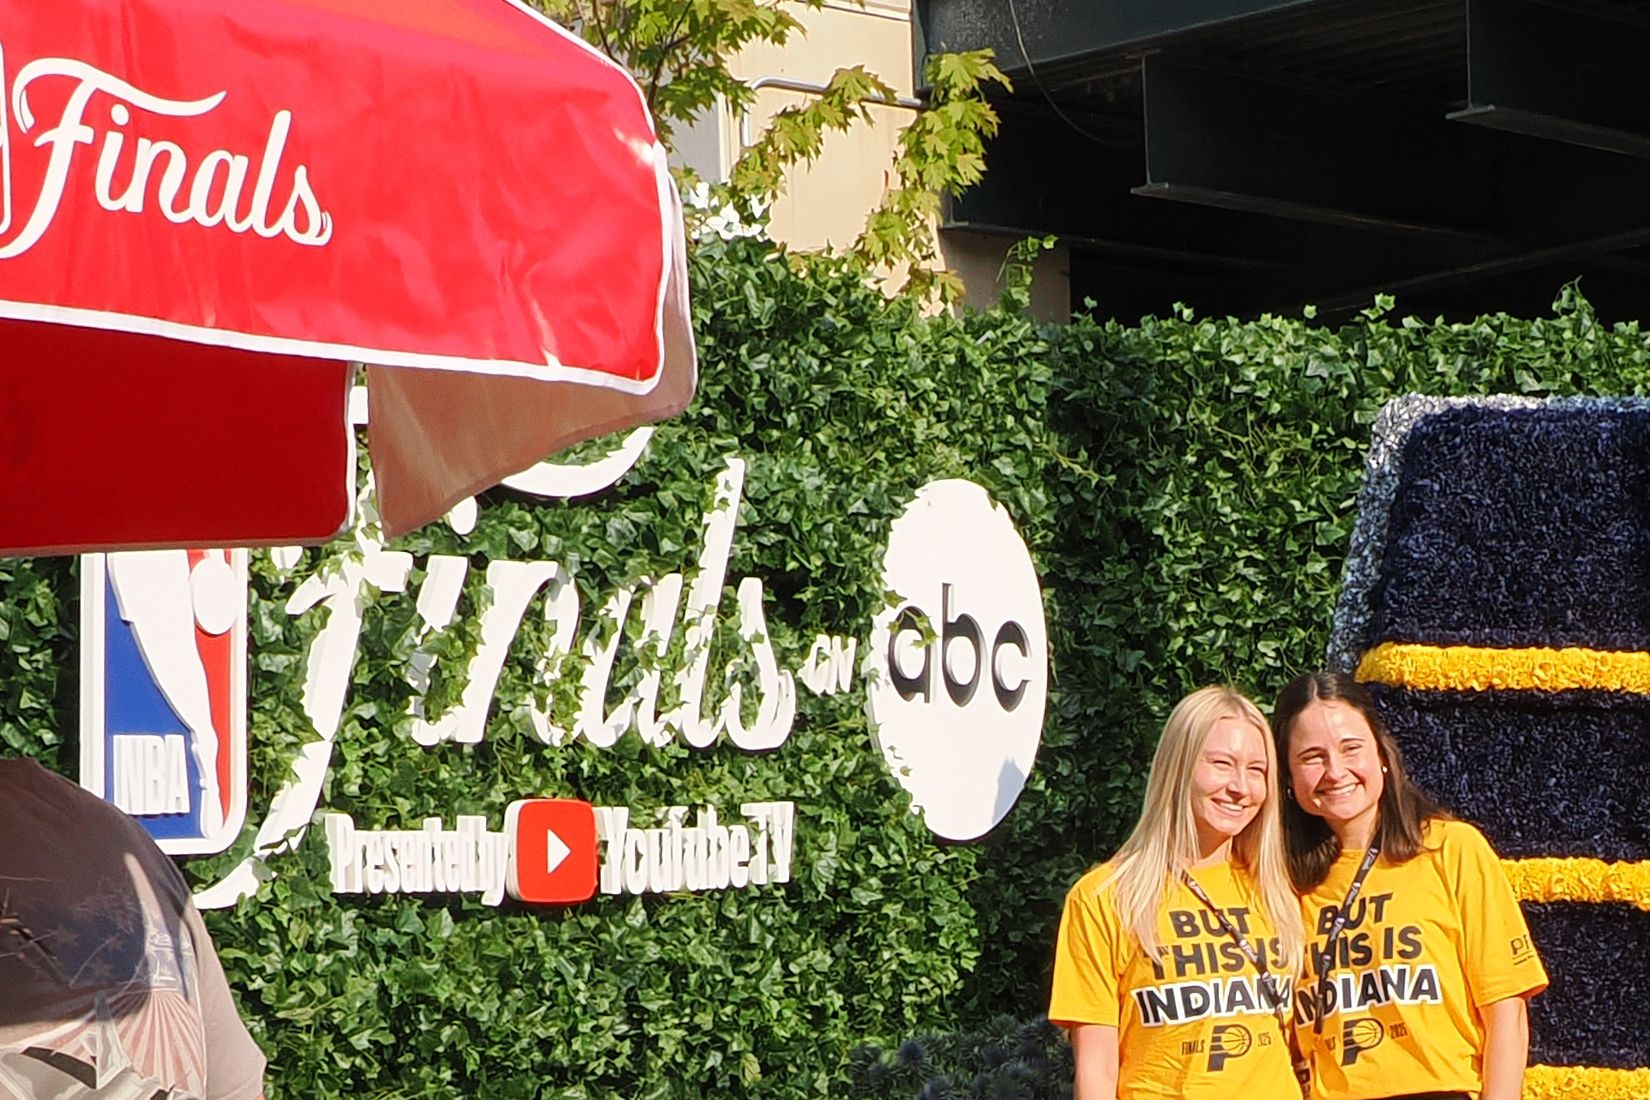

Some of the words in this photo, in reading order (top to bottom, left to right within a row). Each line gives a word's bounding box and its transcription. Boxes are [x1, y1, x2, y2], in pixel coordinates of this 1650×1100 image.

[0, 57, 333, 258] Finals
[887, 582, 1033, 713] abc
[112, 734, 191, 815] NBA
[325, 812, 476, 894] Presented
[474, 815, 508, 906] by
[741, 800, 795, 885] TV
[1168, 907, 1251, 939] BUT
[1317, 892, 1394, 936] BUT
[1383, 925, 1423, 960] IS
[1296, 968, 1439, 1026] NDIANA
